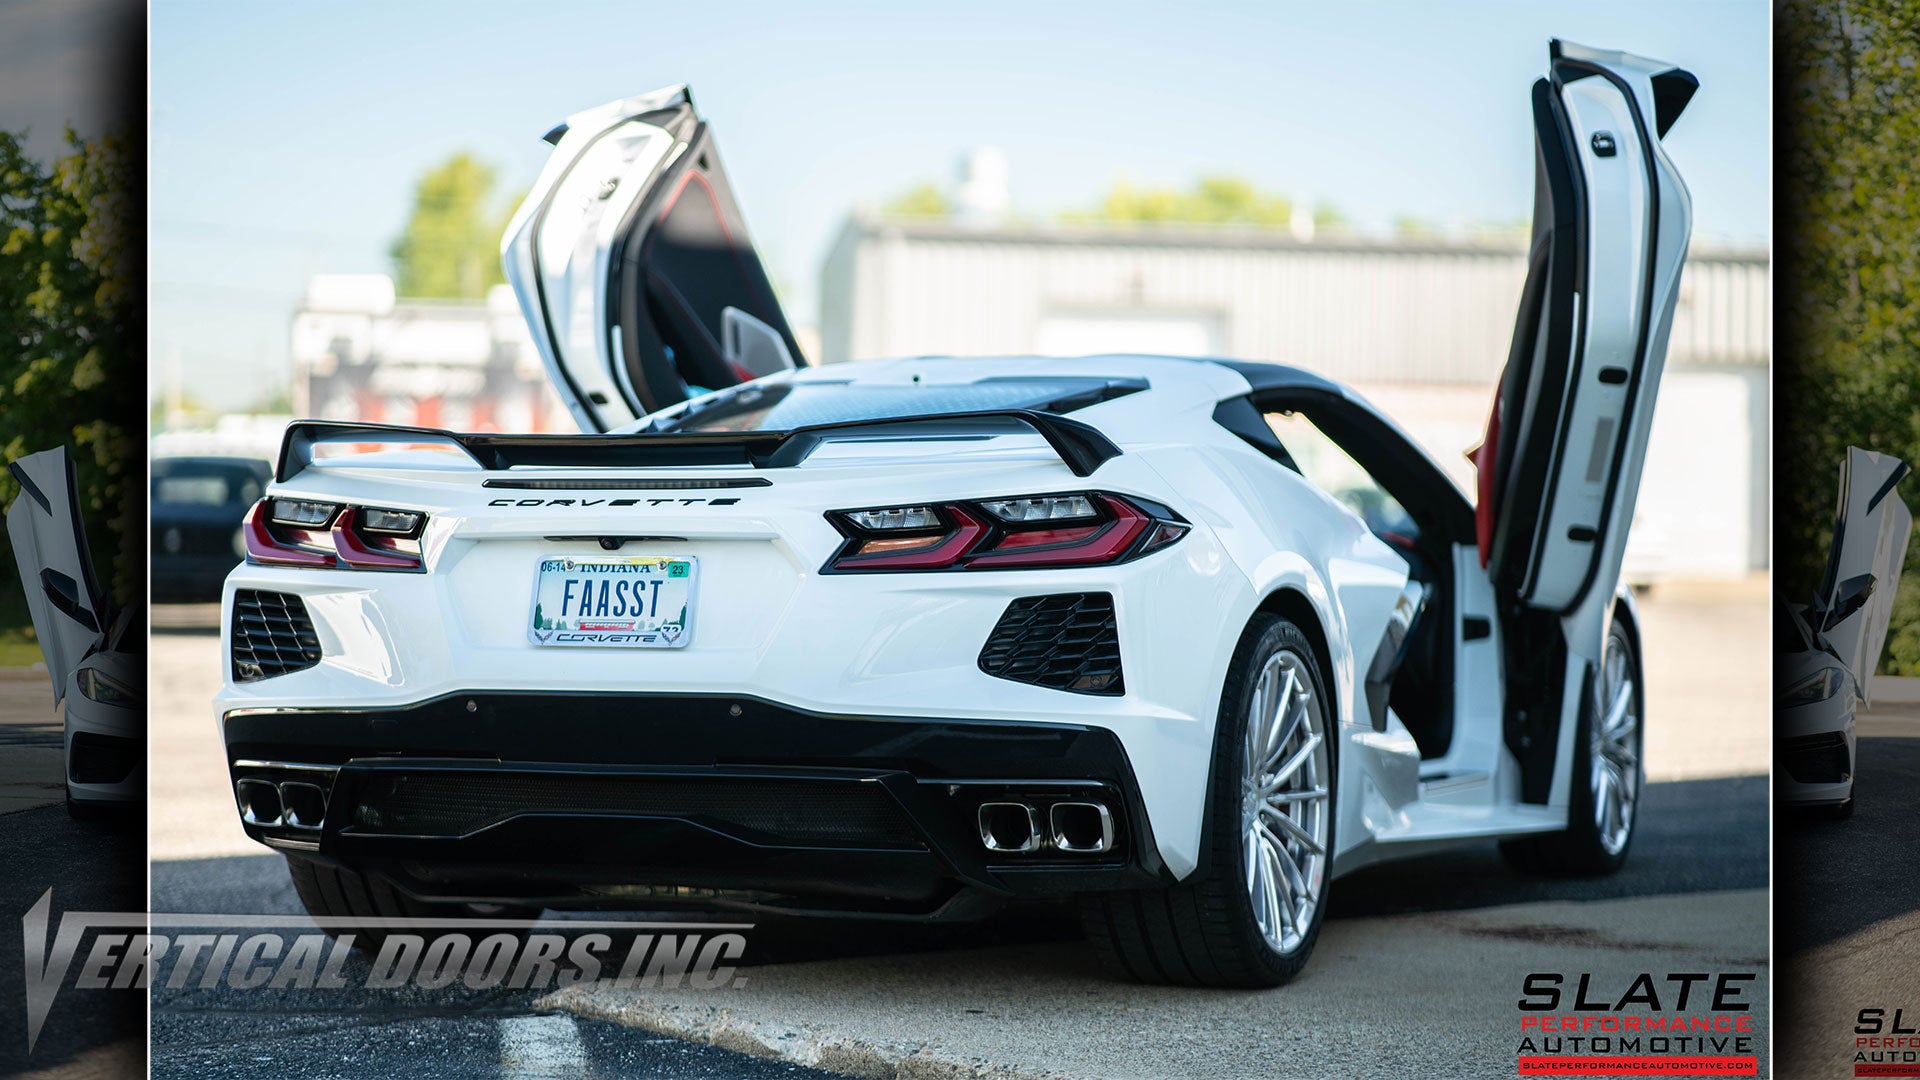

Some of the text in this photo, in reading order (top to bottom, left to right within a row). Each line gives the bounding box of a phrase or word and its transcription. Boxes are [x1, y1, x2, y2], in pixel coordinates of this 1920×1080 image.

[488, 498, 742, 507] CORVETTE
[580, 564, 652, 573] INDIANA
[671, 564, 685, 576] 23
[561, 579, 664, 618] FAASST
[556, 633, 658, 643] CORVETTE
